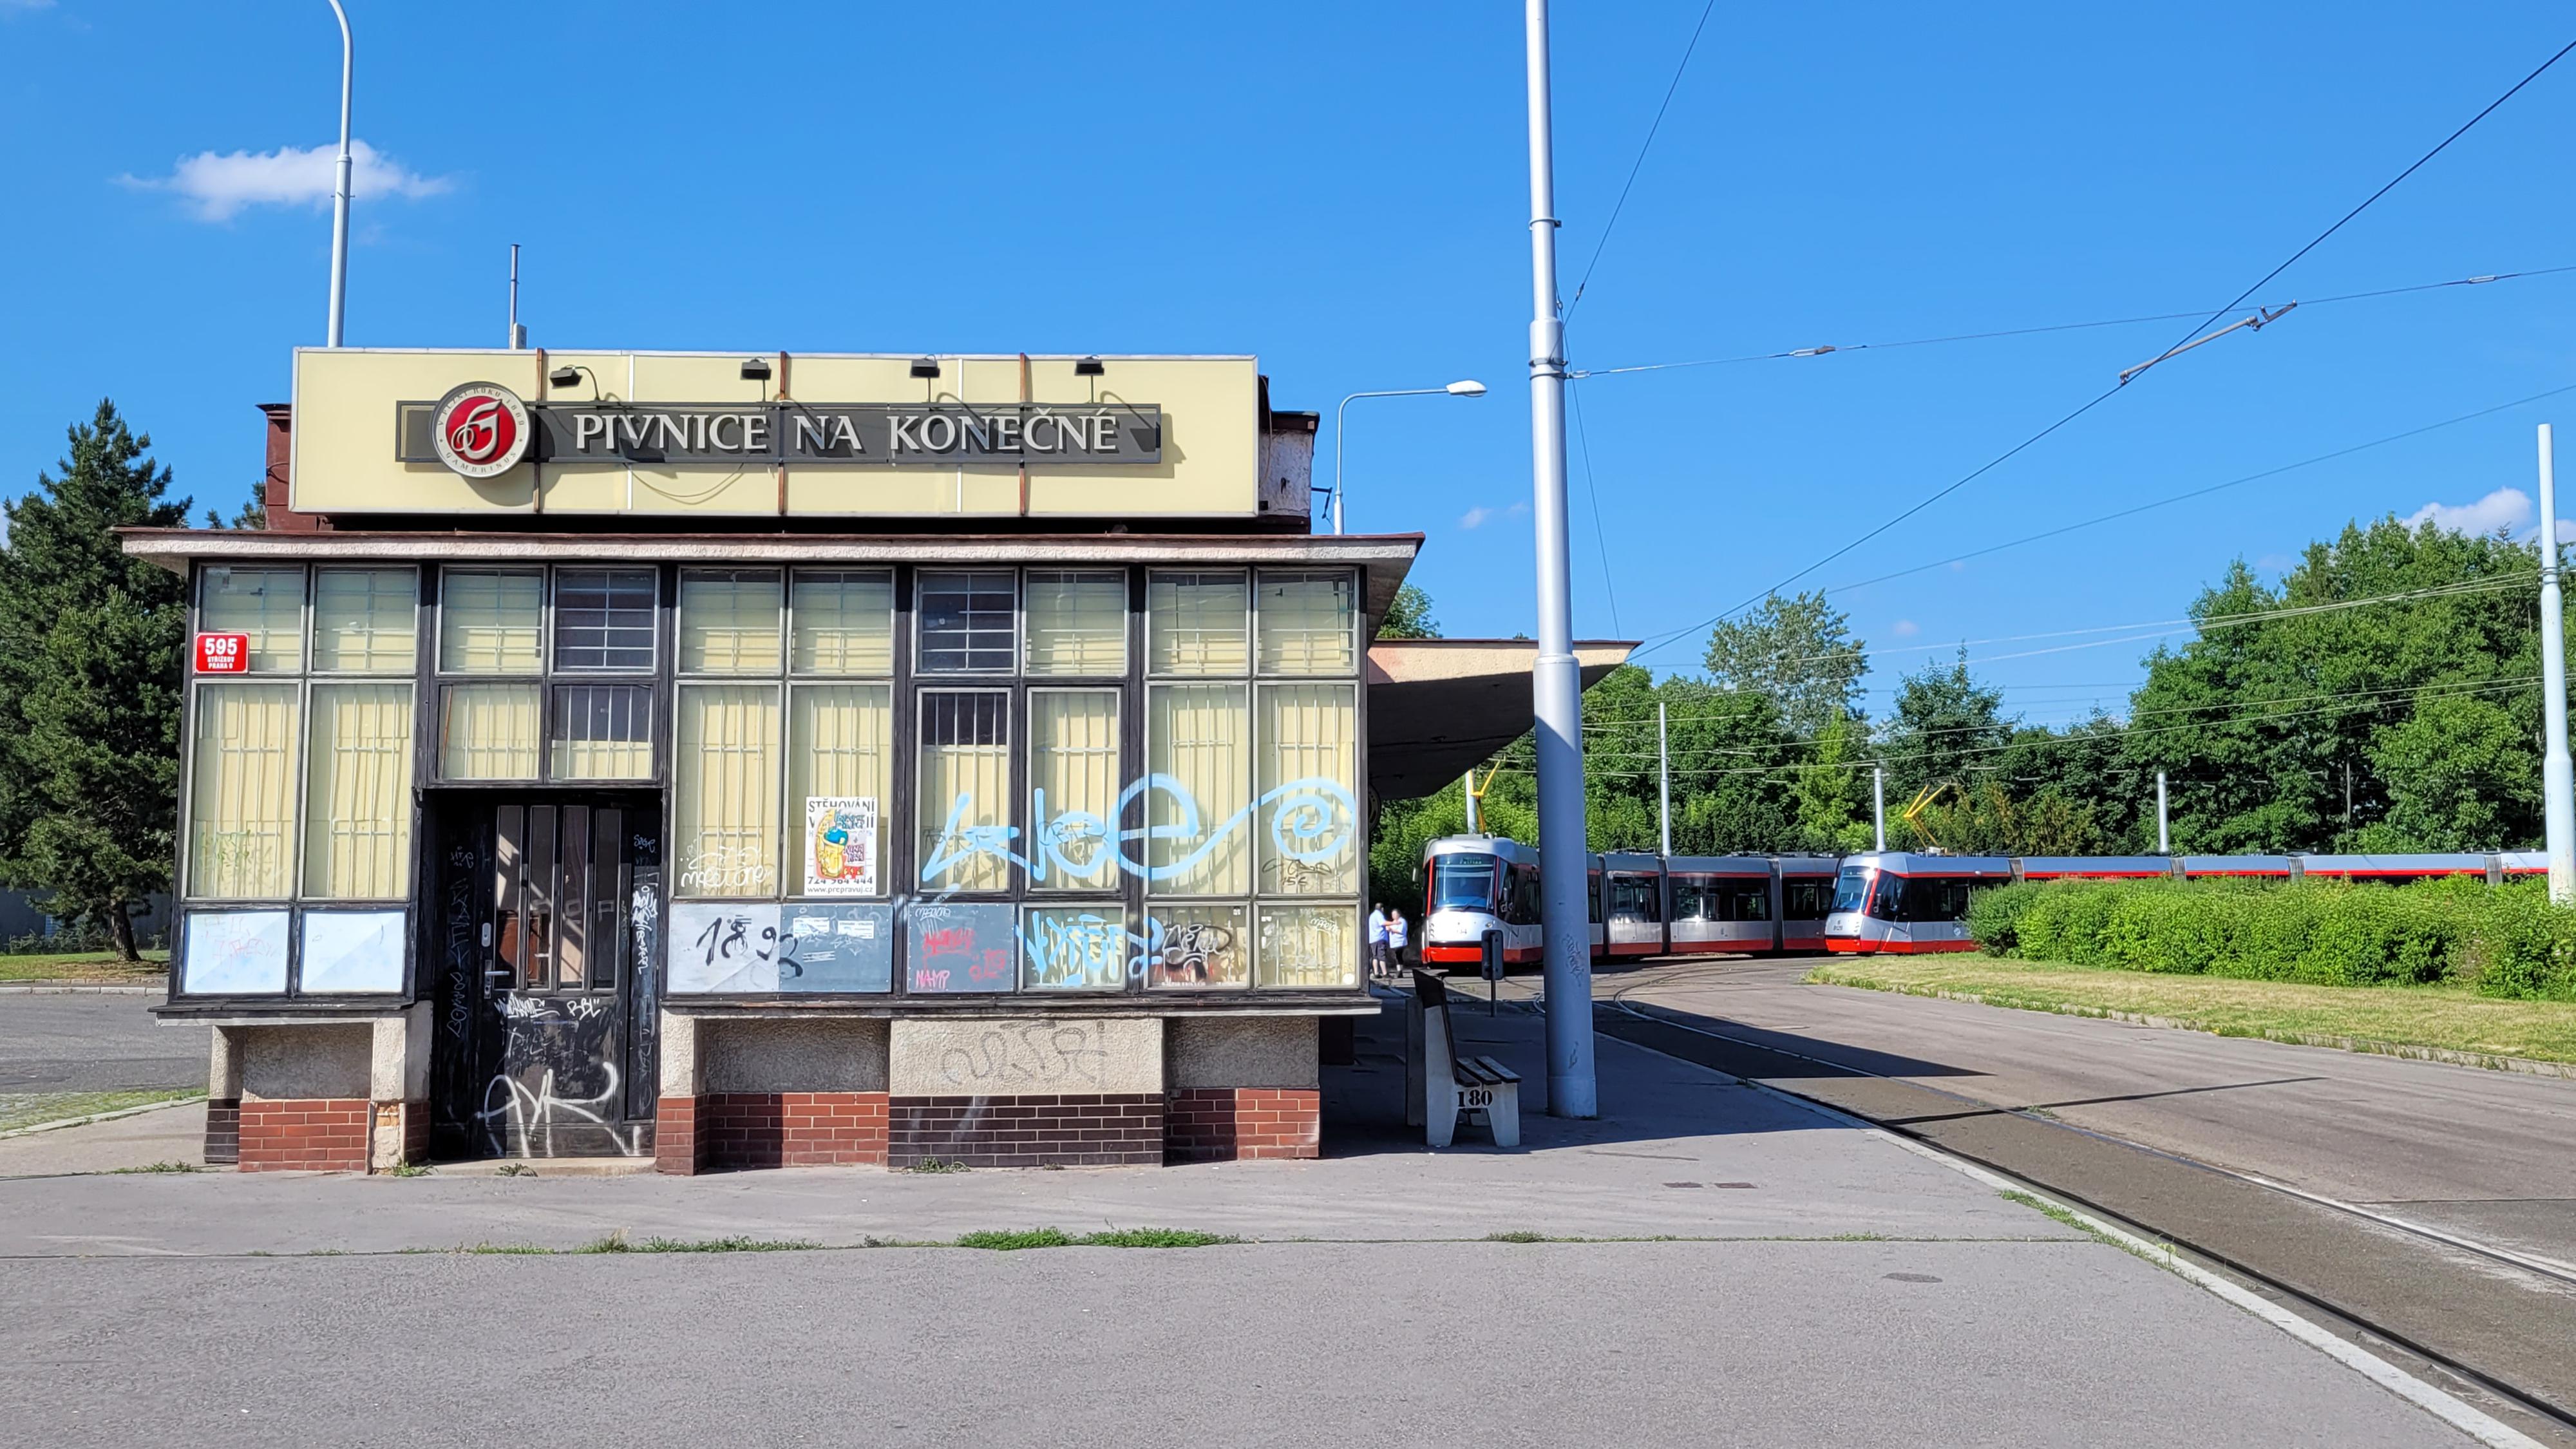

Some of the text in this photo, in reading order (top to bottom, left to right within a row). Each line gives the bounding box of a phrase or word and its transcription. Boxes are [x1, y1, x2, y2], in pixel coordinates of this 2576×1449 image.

[573, 407, 1118, 451] PIVNICE NA KONEČNÉ
[445, 452, 516, 473] GAMBRINUS
[205, 638, 238, 655] 595
[808, 886, 874, 895] www.prepravuj.cz
[1457, 1089, 1493, 1107] 180
